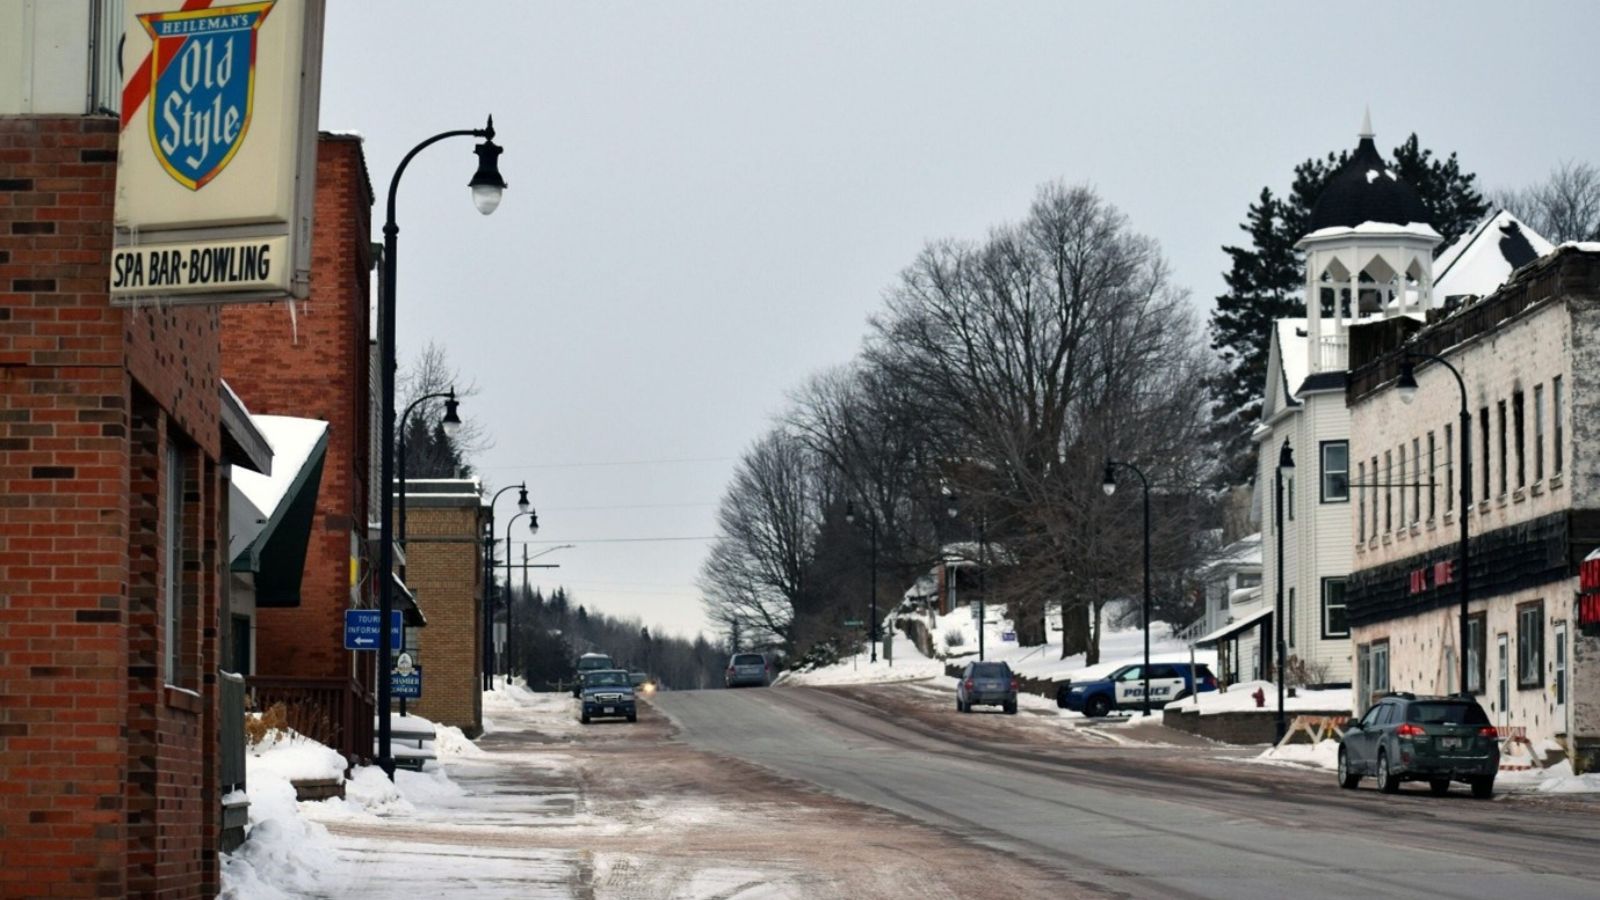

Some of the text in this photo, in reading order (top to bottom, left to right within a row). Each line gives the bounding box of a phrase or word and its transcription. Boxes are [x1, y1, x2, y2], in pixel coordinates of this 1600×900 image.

[161, 14, 250, 34] HEILEMAN'S
[180, 36, 233, 95] Old
[161, 92, 239, 170] Style
[113, 252, 144, 287] SPA
